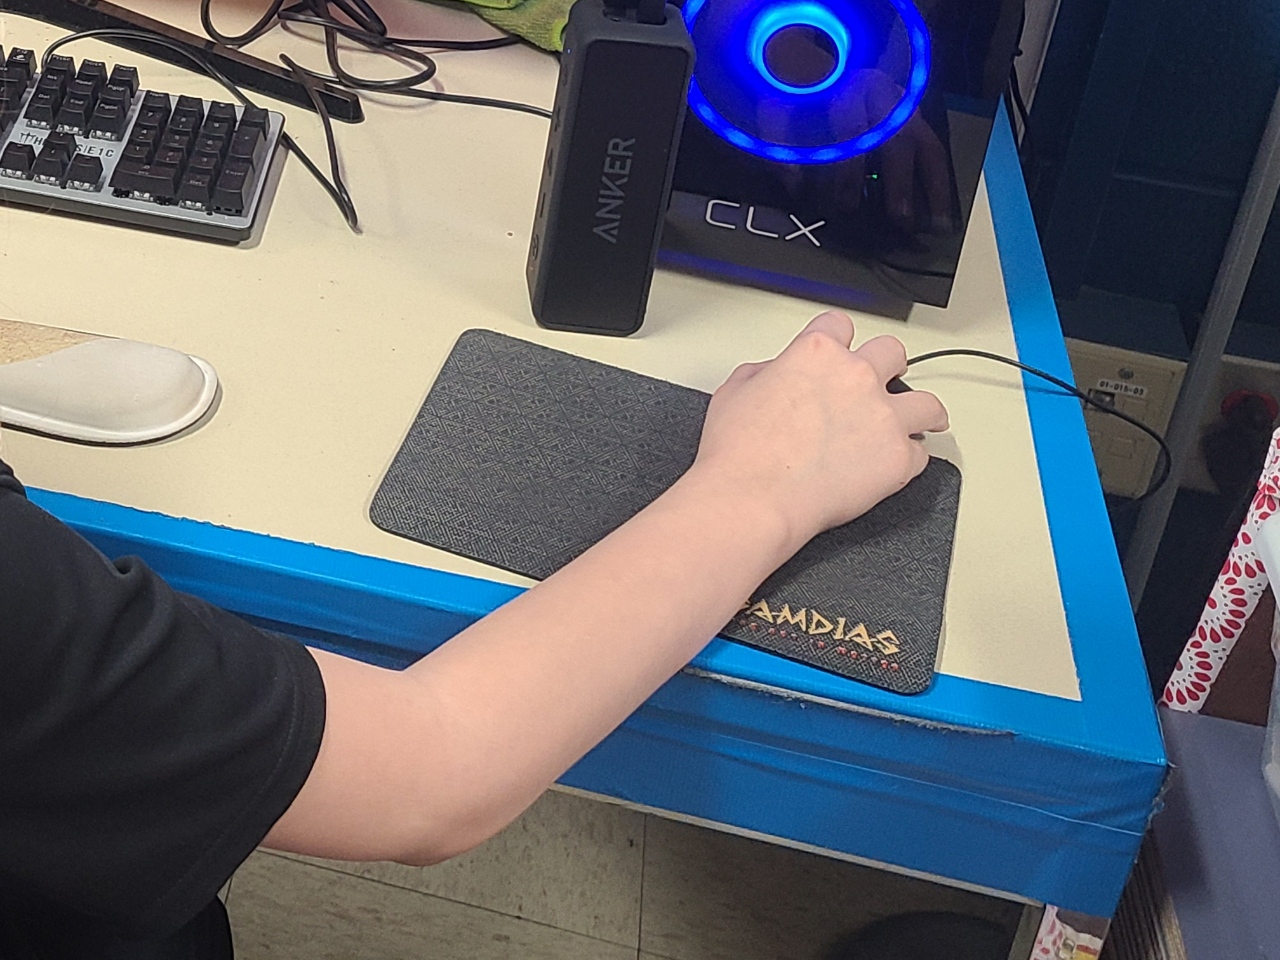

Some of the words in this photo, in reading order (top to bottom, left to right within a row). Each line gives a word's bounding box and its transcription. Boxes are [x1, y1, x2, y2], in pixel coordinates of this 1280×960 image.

[593, 137, 636, 244] ANKER
[705, 199, 825, 247] CLX
[742, 598, 900, 655] AMDIAS
